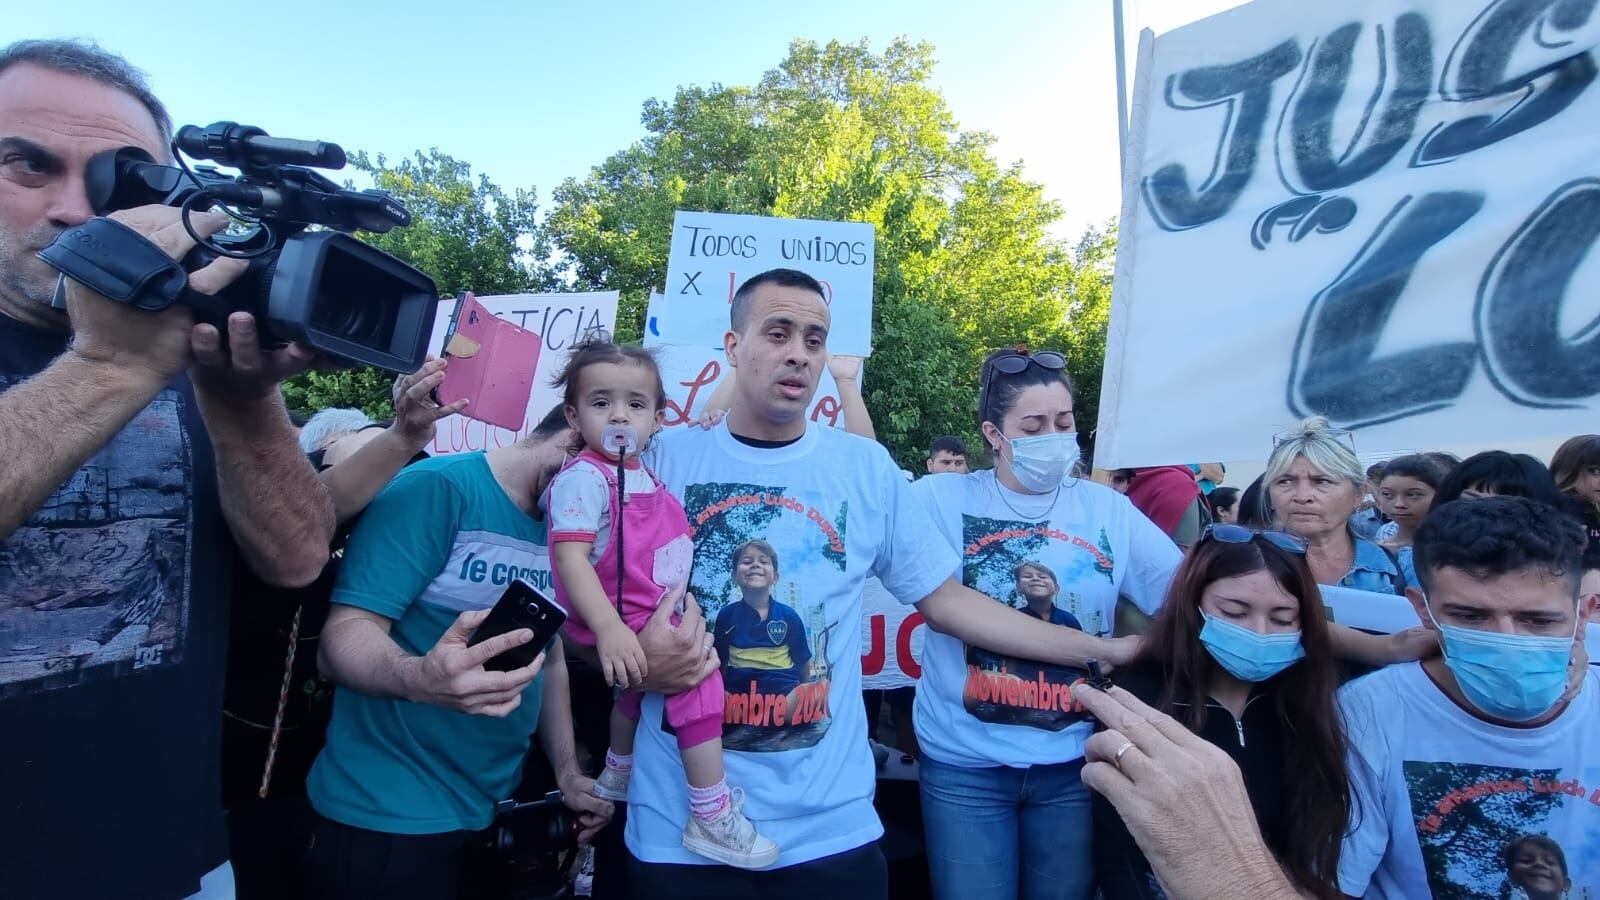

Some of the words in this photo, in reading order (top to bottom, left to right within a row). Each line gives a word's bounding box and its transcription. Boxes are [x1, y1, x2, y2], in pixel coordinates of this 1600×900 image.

[683, 225, 758, 259] TODOS
[680, 271, 703, 296] X
[459, 552, 488, 583] le
[966, 664, 1072, 713] Noviembre
